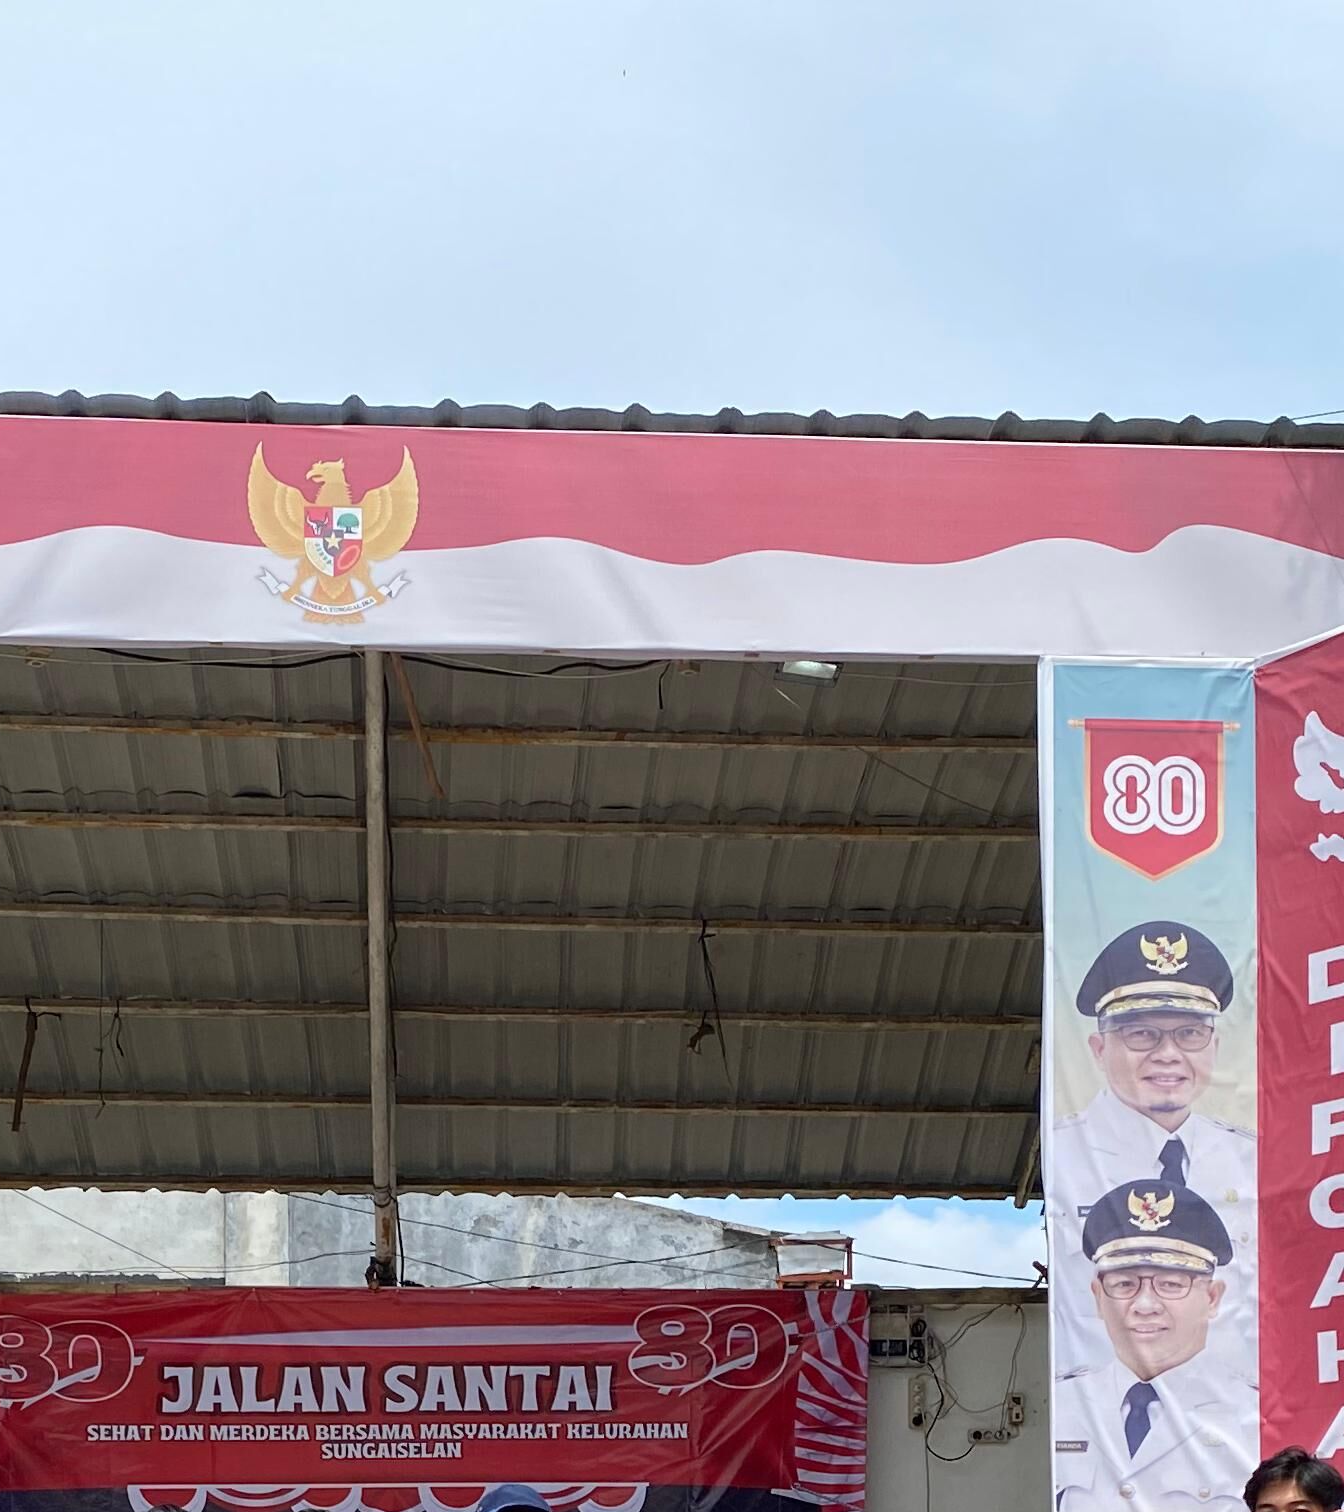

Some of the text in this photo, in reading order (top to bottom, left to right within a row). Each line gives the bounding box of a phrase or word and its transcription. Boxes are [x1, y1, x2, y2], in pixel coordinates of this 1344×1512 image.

[1103, 755, 1207, 835] 80
[628, 1304, 790, 1389] 80
[161, 1364, 614, 1414] JALAN SANTAI
[86, 1422, 689, 1442] SEHAT DAN MERDEKA BERSAMA MASYARAKAT KELURAHAN
[320, 1441, 463, 1460] SUNGAISELAN
